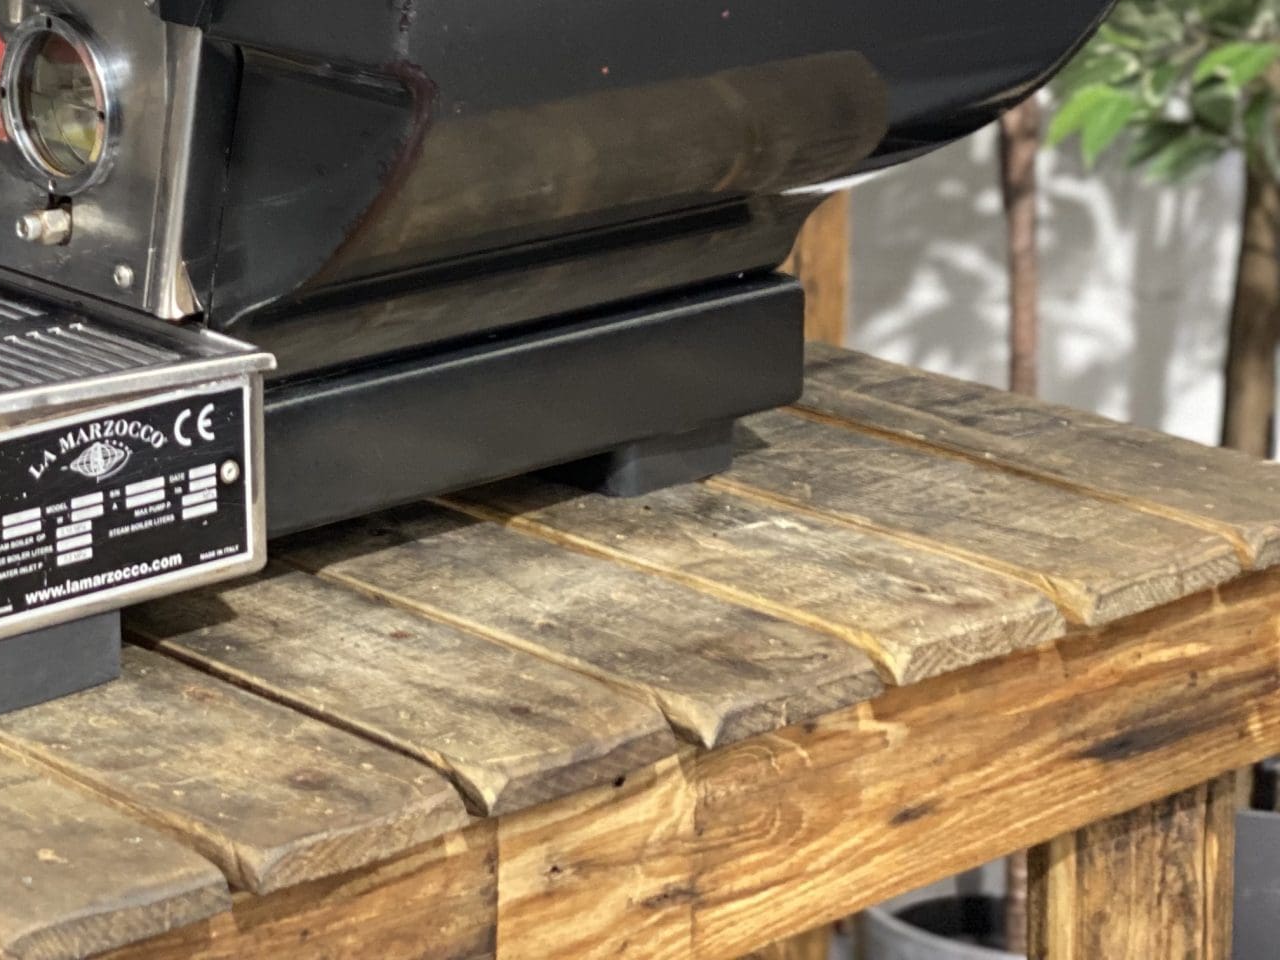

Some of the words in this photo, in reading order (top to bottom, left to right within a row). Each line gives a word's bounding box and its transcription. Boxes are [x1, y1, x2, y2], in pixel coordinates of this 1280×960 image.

[28, 450, 57, 479] LA
[58, 419, 164, 454] MARZOCCO
[7, 551, 30, 564] BOILER
[25, 553, 182, 605] www.lamarzocco.com
